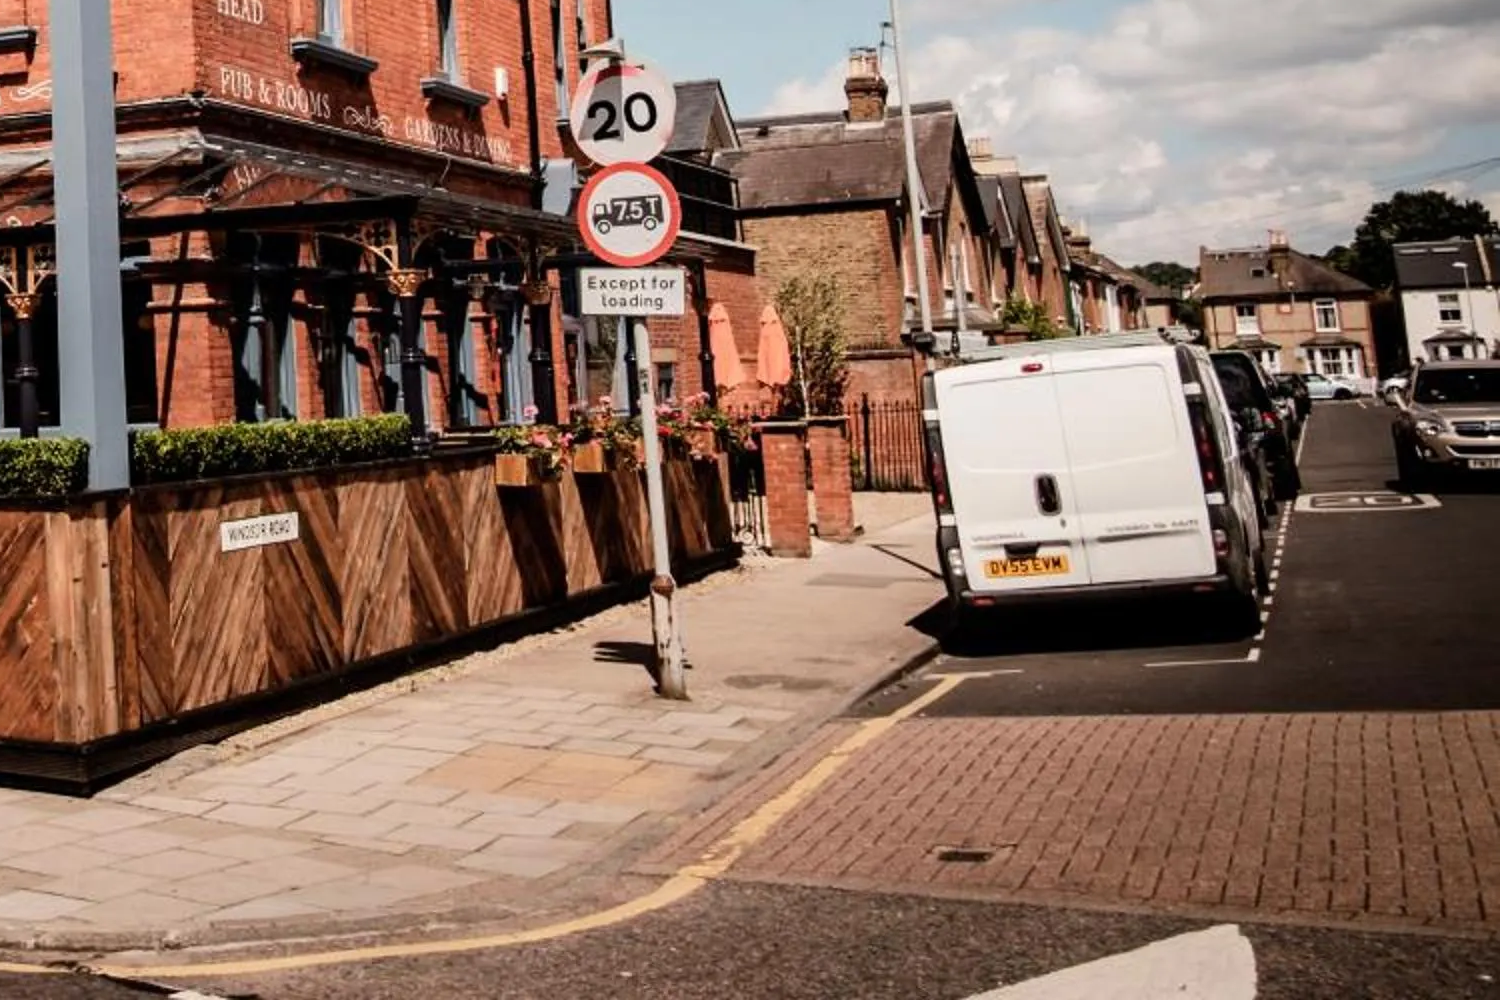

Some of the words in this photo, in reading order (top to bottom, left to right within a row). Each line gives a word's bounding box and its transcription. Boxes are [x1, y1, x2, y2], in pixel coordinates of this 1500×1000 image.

[220, 66, 253, 100] PUB
[259, 77, 272, 105] &
[276, 80, 332, 119] ROOMS
[587, 92, 657, 141] 20
[587, 275, 646, 292] Except
[651, 275, 676, 290] for
[601, 294, 664, 310] loading
